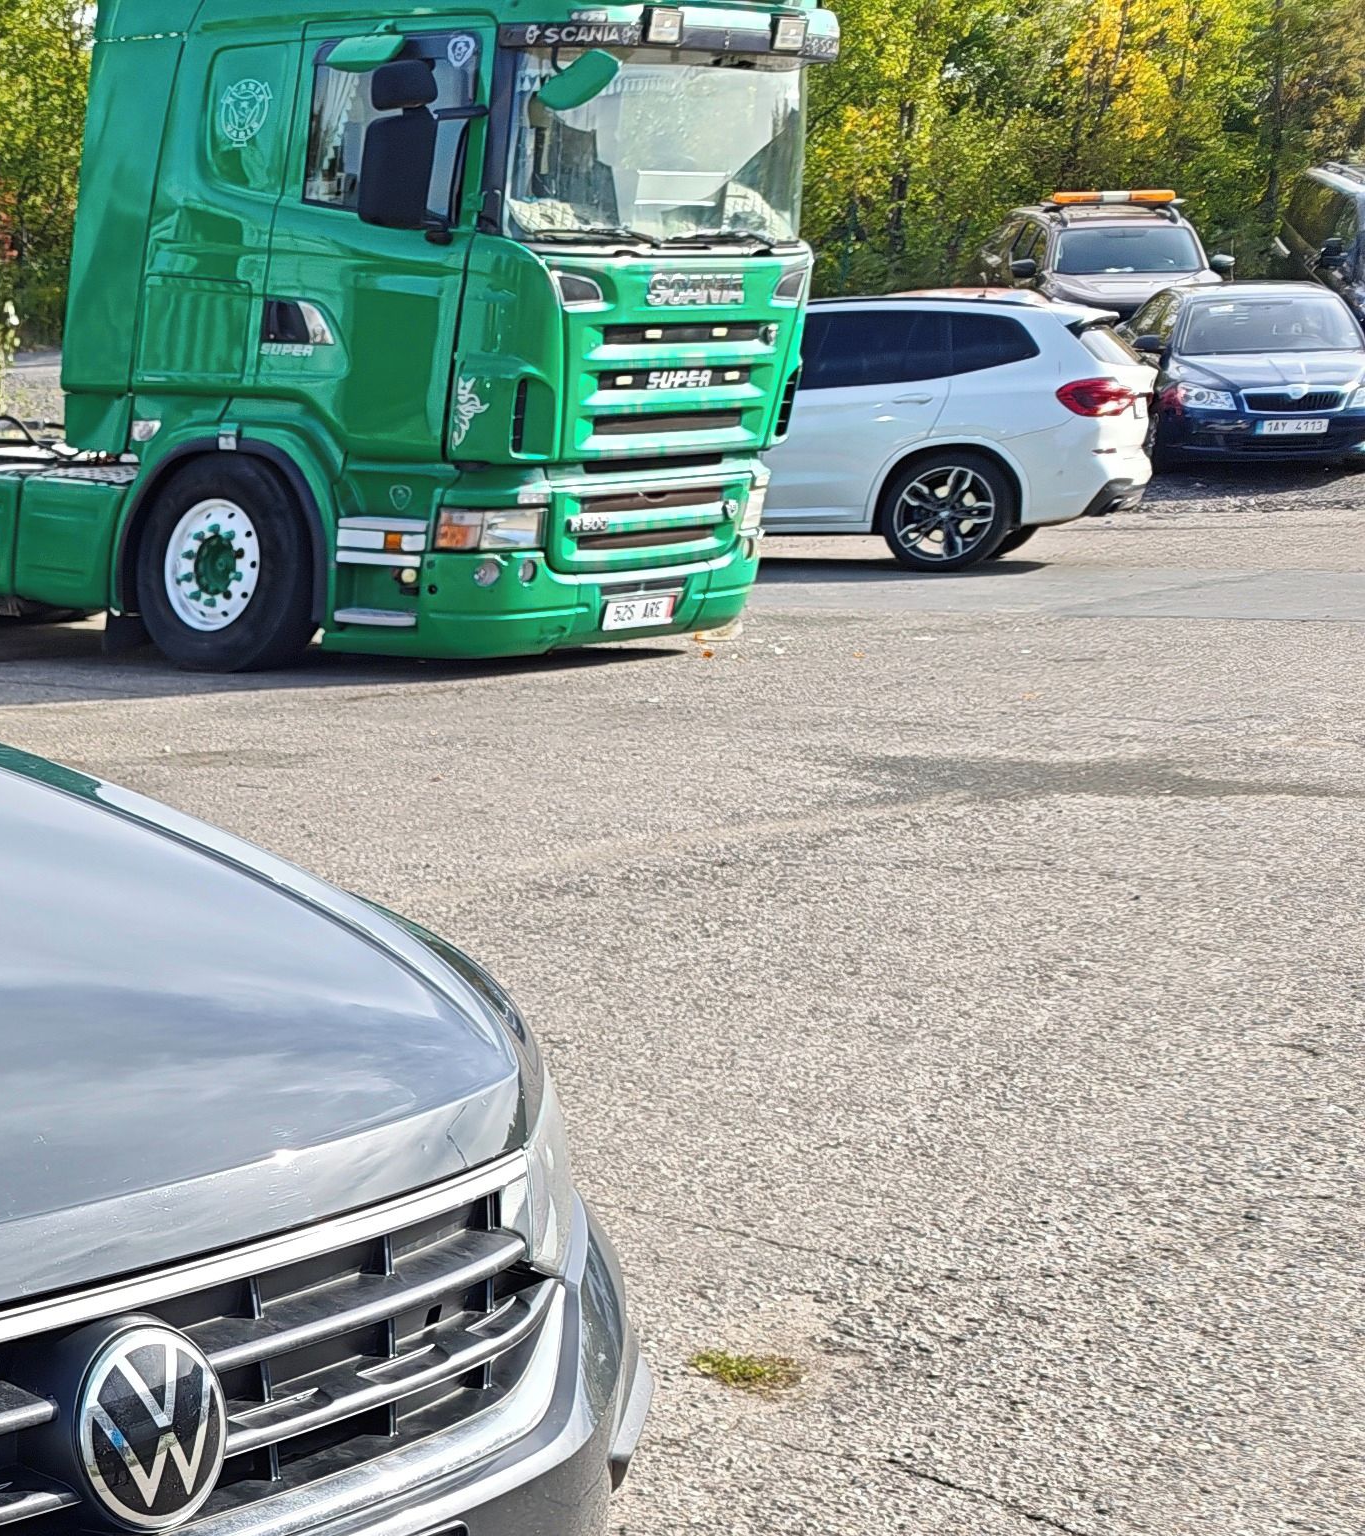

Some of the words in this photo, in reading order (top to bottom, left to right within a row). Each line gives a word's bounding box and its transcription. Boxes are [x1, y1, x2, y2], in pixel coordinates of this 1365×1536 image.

[544, 26, 620, 44] SCANIA
[646, 272, 745, 306] SCANIA
[259, 342, 314, 357] SUPER
[646, 369, 713, 390] SUPER
